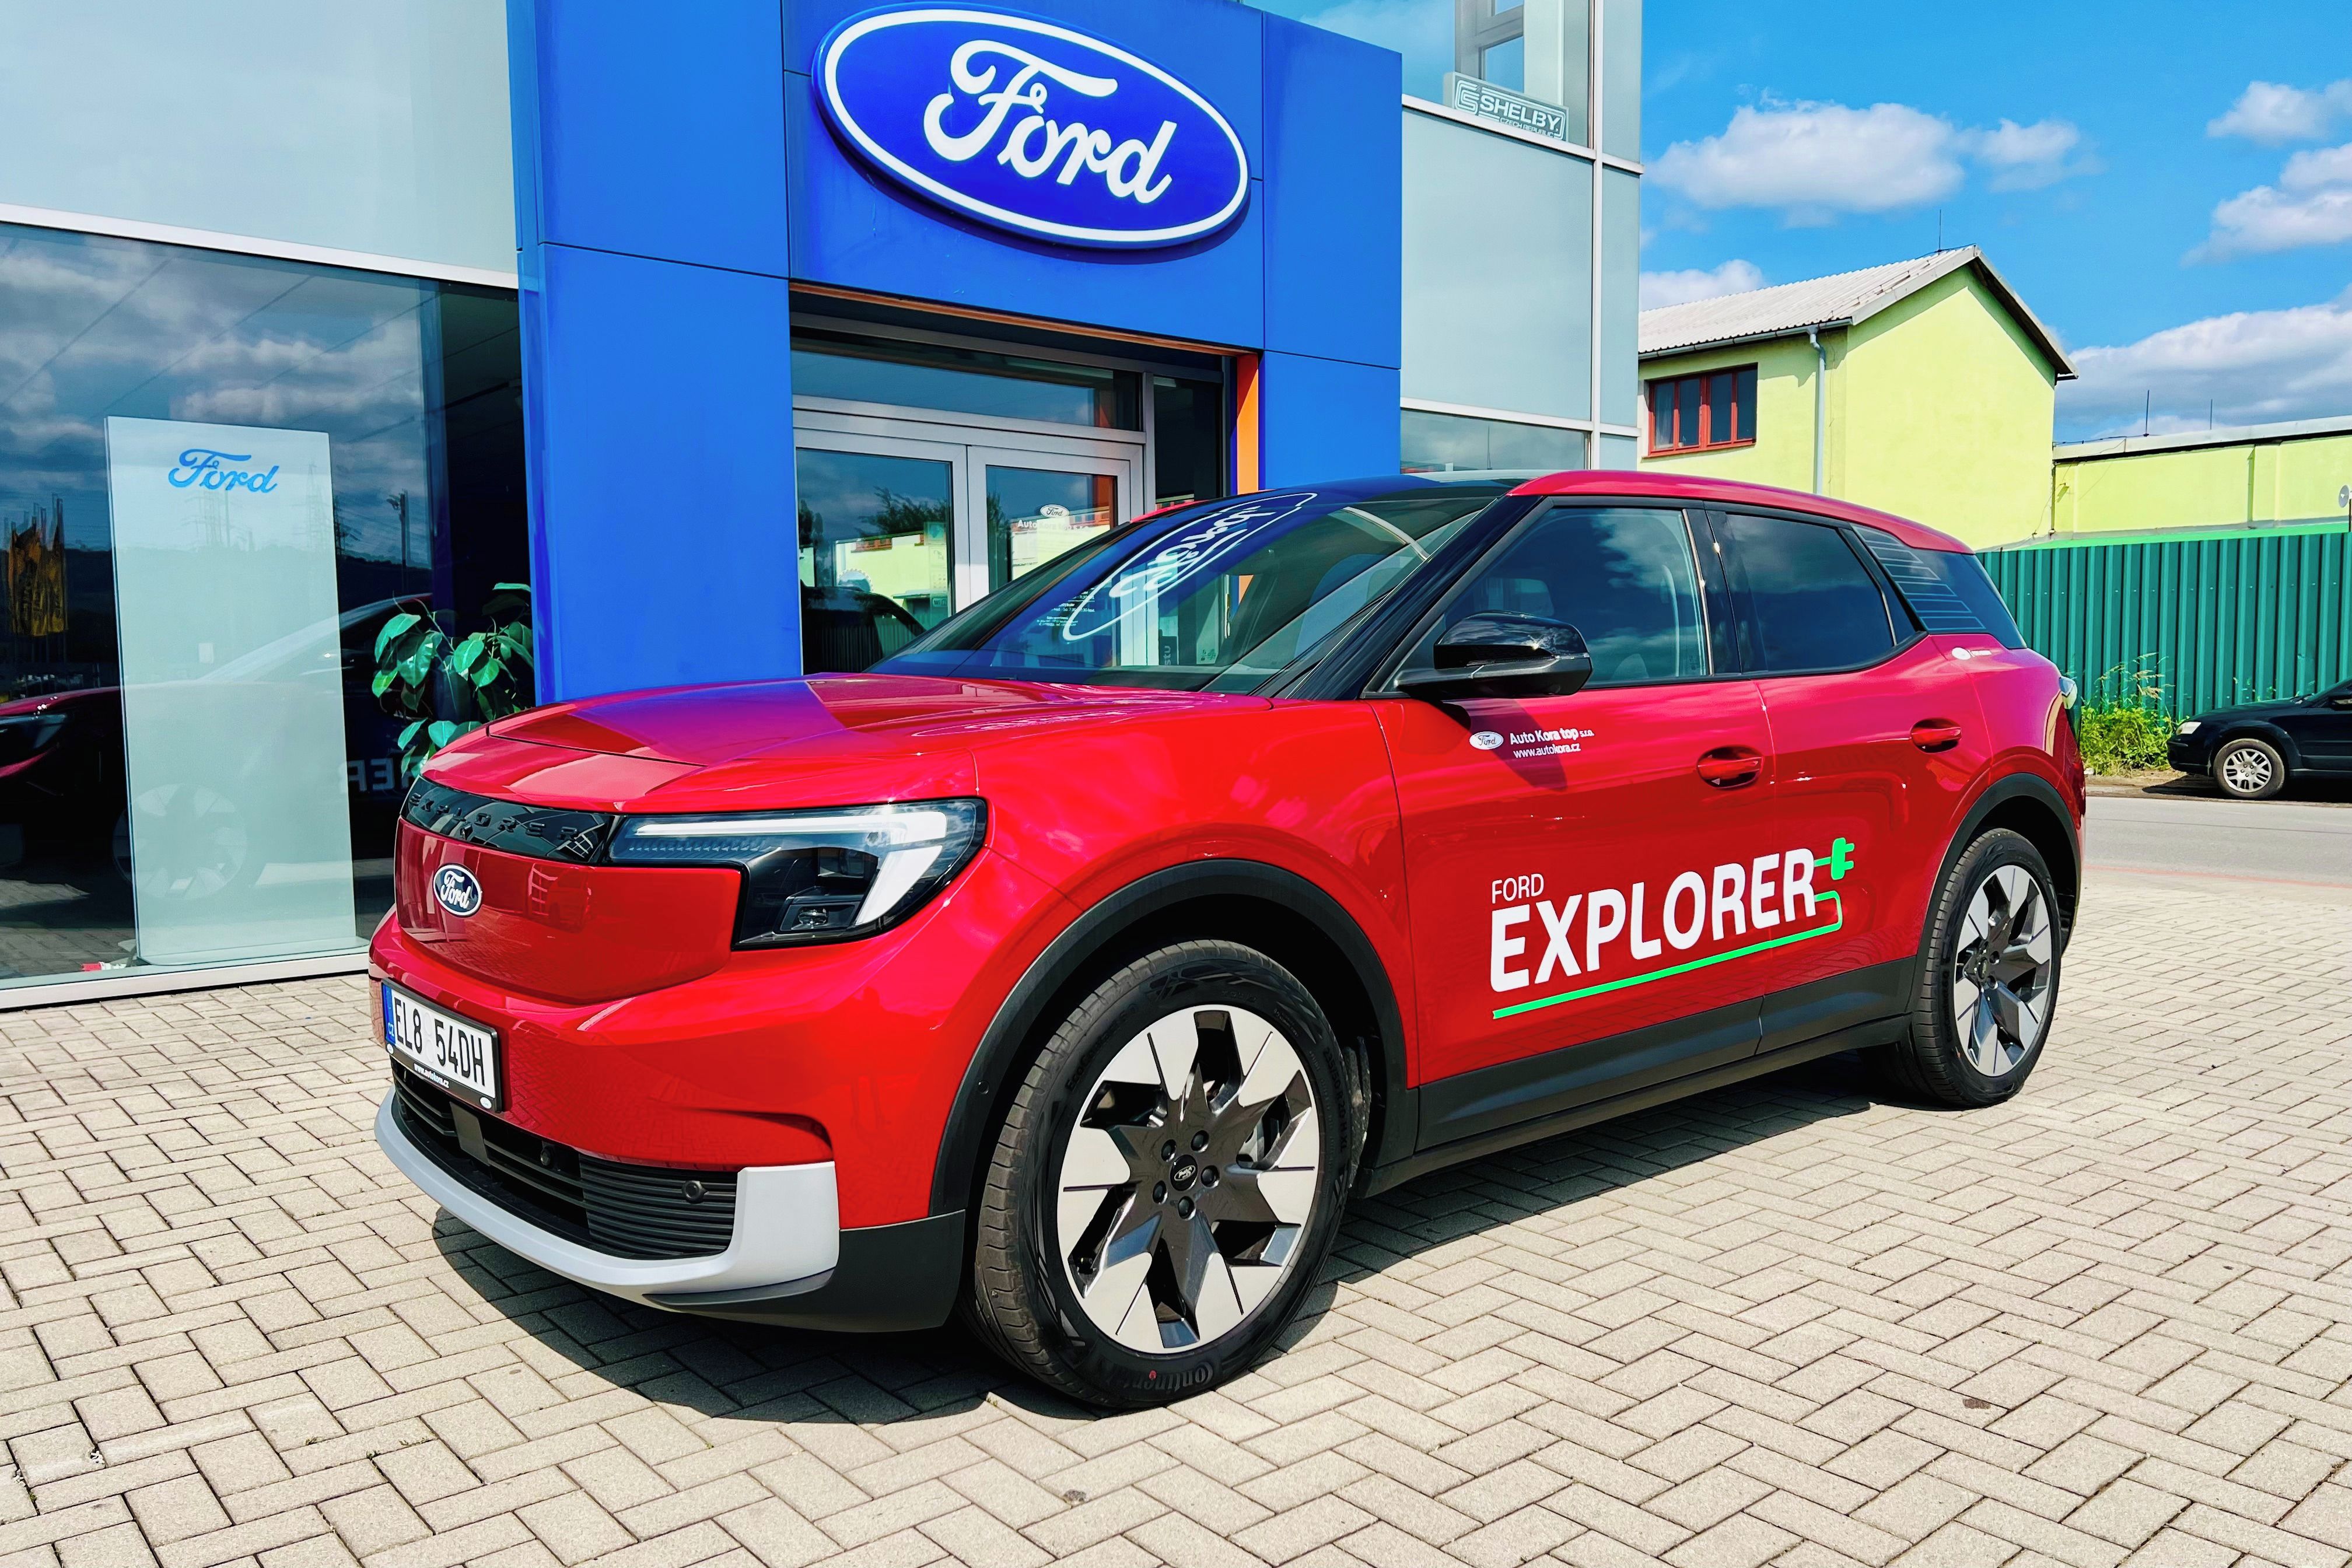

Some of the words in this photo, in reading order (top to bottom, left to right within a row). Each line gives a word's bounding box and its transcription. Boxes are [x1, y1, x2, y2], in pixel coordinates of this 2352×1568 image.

[924, 40, 1177, 204] Ford
[1500, 117, 1522, 130] CZECH
[1522, 124, 1554, 138] REPUBLIC
[168, 449, 279, 494] Ford
[1017, 519, 1037, 528] Auto
[1510, 733, 1535, 745] Auto
[1536, 730, 1561, 743] Kora
[1560, 728, 1579, 741] top
[1513, 743, 1581, 758] www.autokora.cz
[410, 793, 579, 841] EXPLORER
[440, 869, 471, 909] Ford
[1492, 873, 1545, 904] FORD
[1490, 848, 1817, 992] EXPLORER
[387, 1022, 395, 1037] CZ
[394, 996, 422, 1054] EL8
[434, 1018, 485, 1087] 54DH
[1322, 1046, 1342, 1089] 235/50
[1340, 1122, 1348, 1132] H
[1102, 1359, 1214, 1394] Continen
